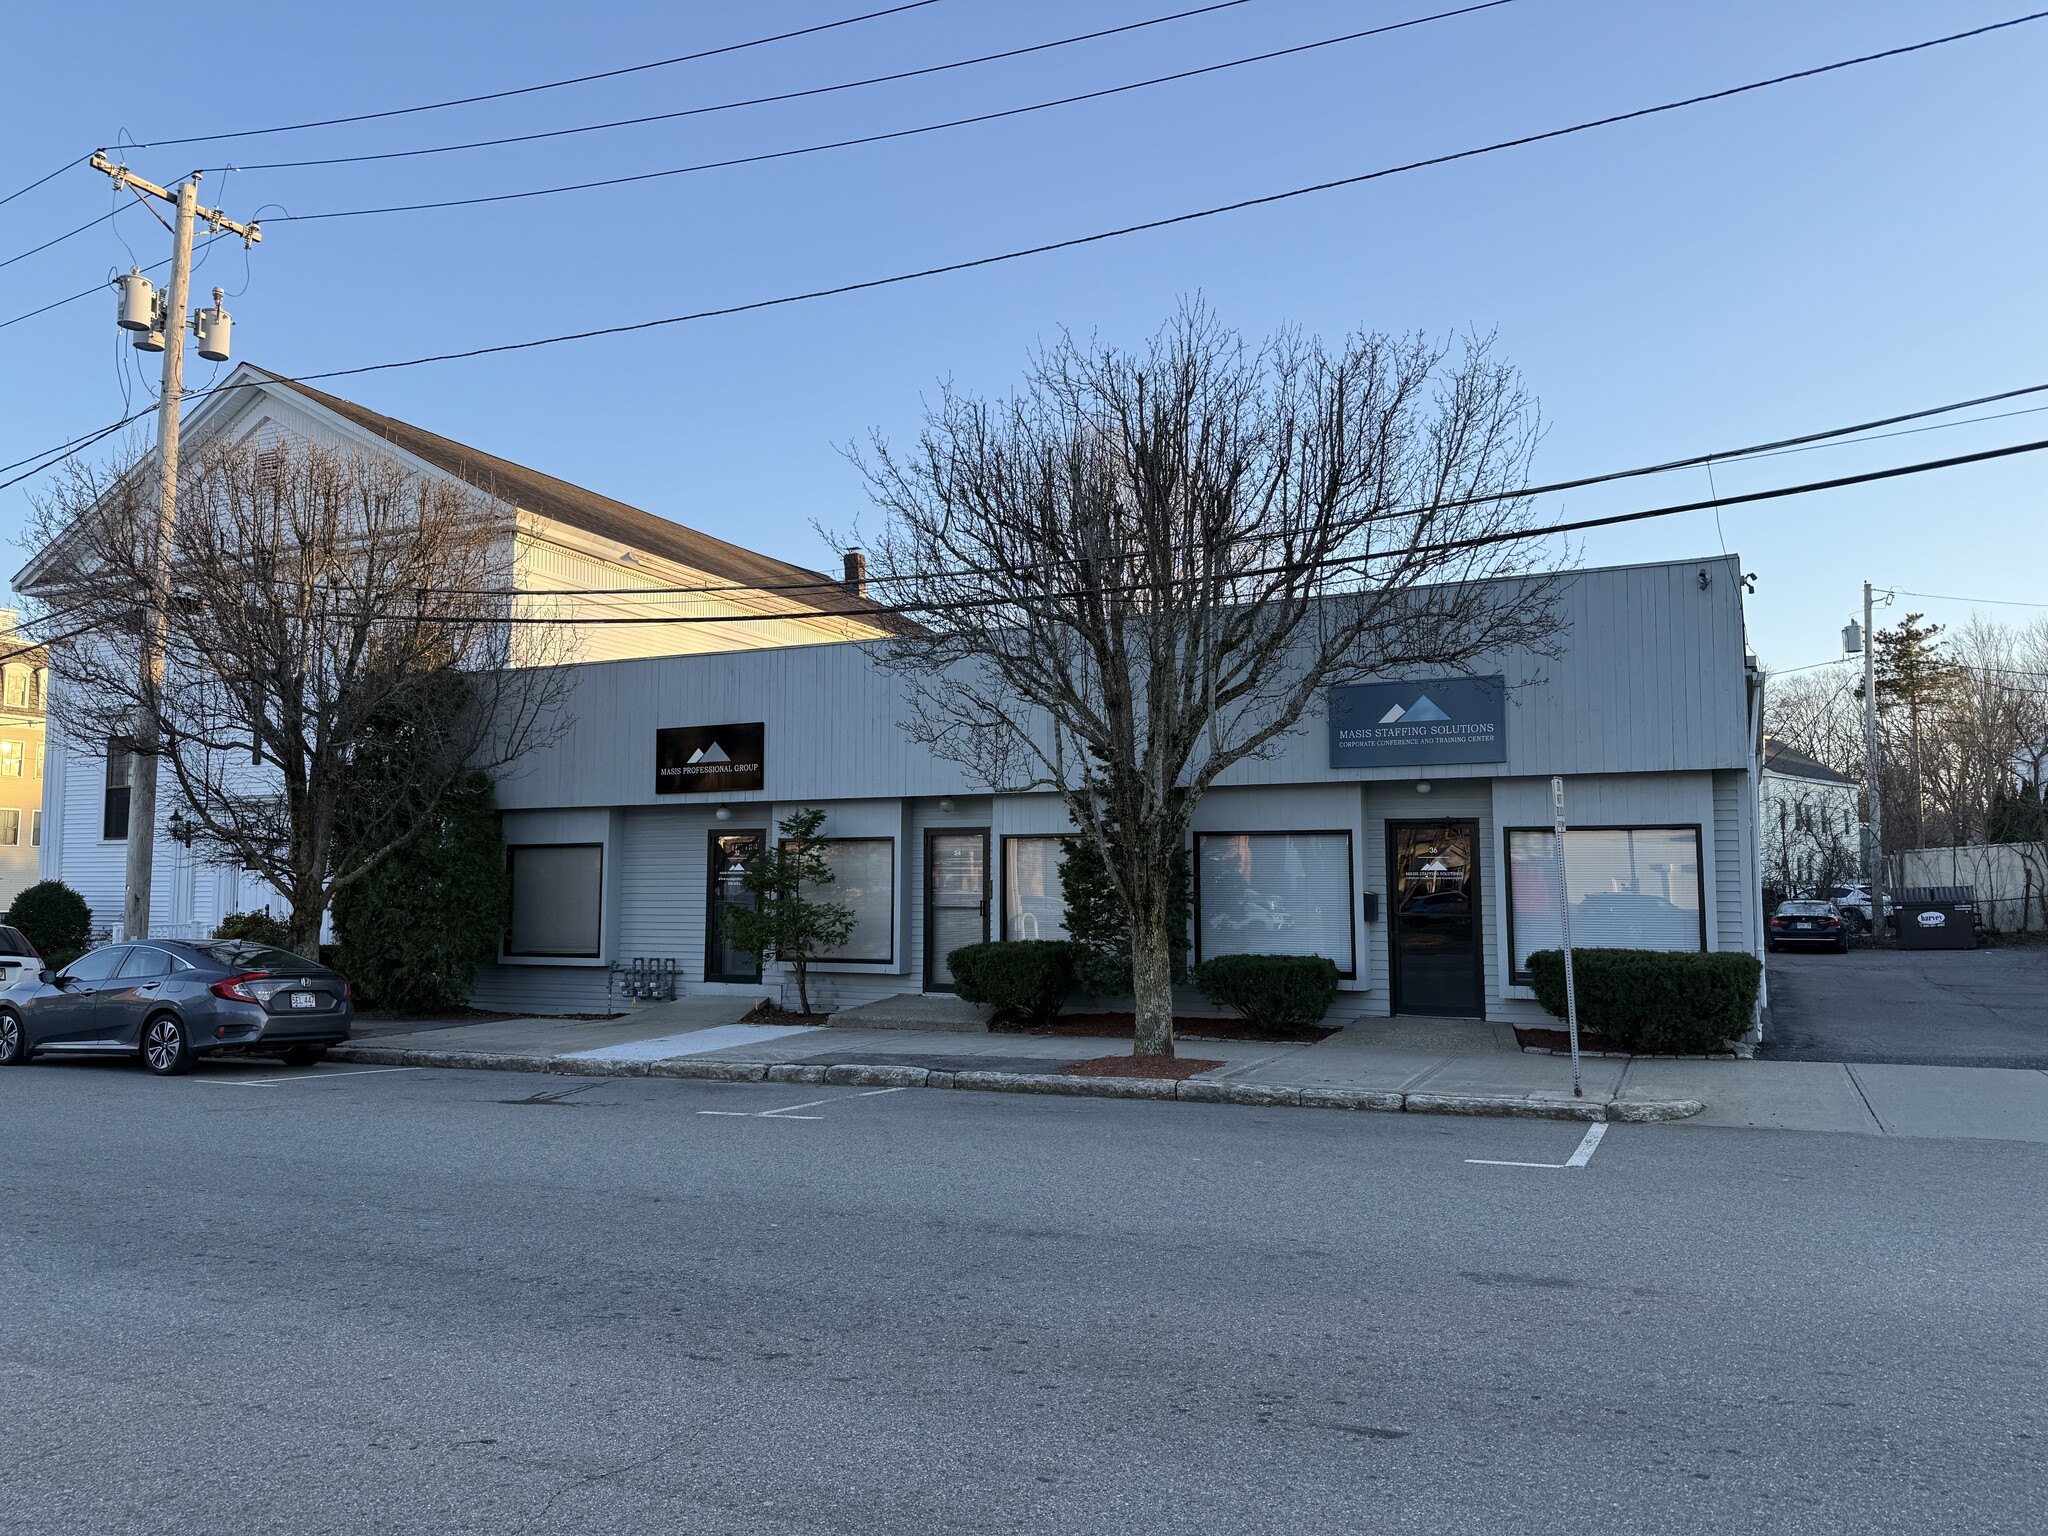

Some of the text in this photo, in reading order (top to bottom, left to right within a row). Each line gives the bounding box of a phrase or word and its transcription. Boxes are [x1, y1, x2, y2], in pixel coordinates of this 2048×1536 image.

[1339, 723, 1494, 739] MASIS STAFFING SOLUTIONS
[1339, 740, 1376, 748] CORPORATE
[1376, 738, 1419, 747] CONFERENCE
[1435, 736, 1466, 744] TRAINING
[1467, 735, 1495, 743] CENTER
[660, 763, 759, 776] MASIS PROFESSIONAL GROUP
